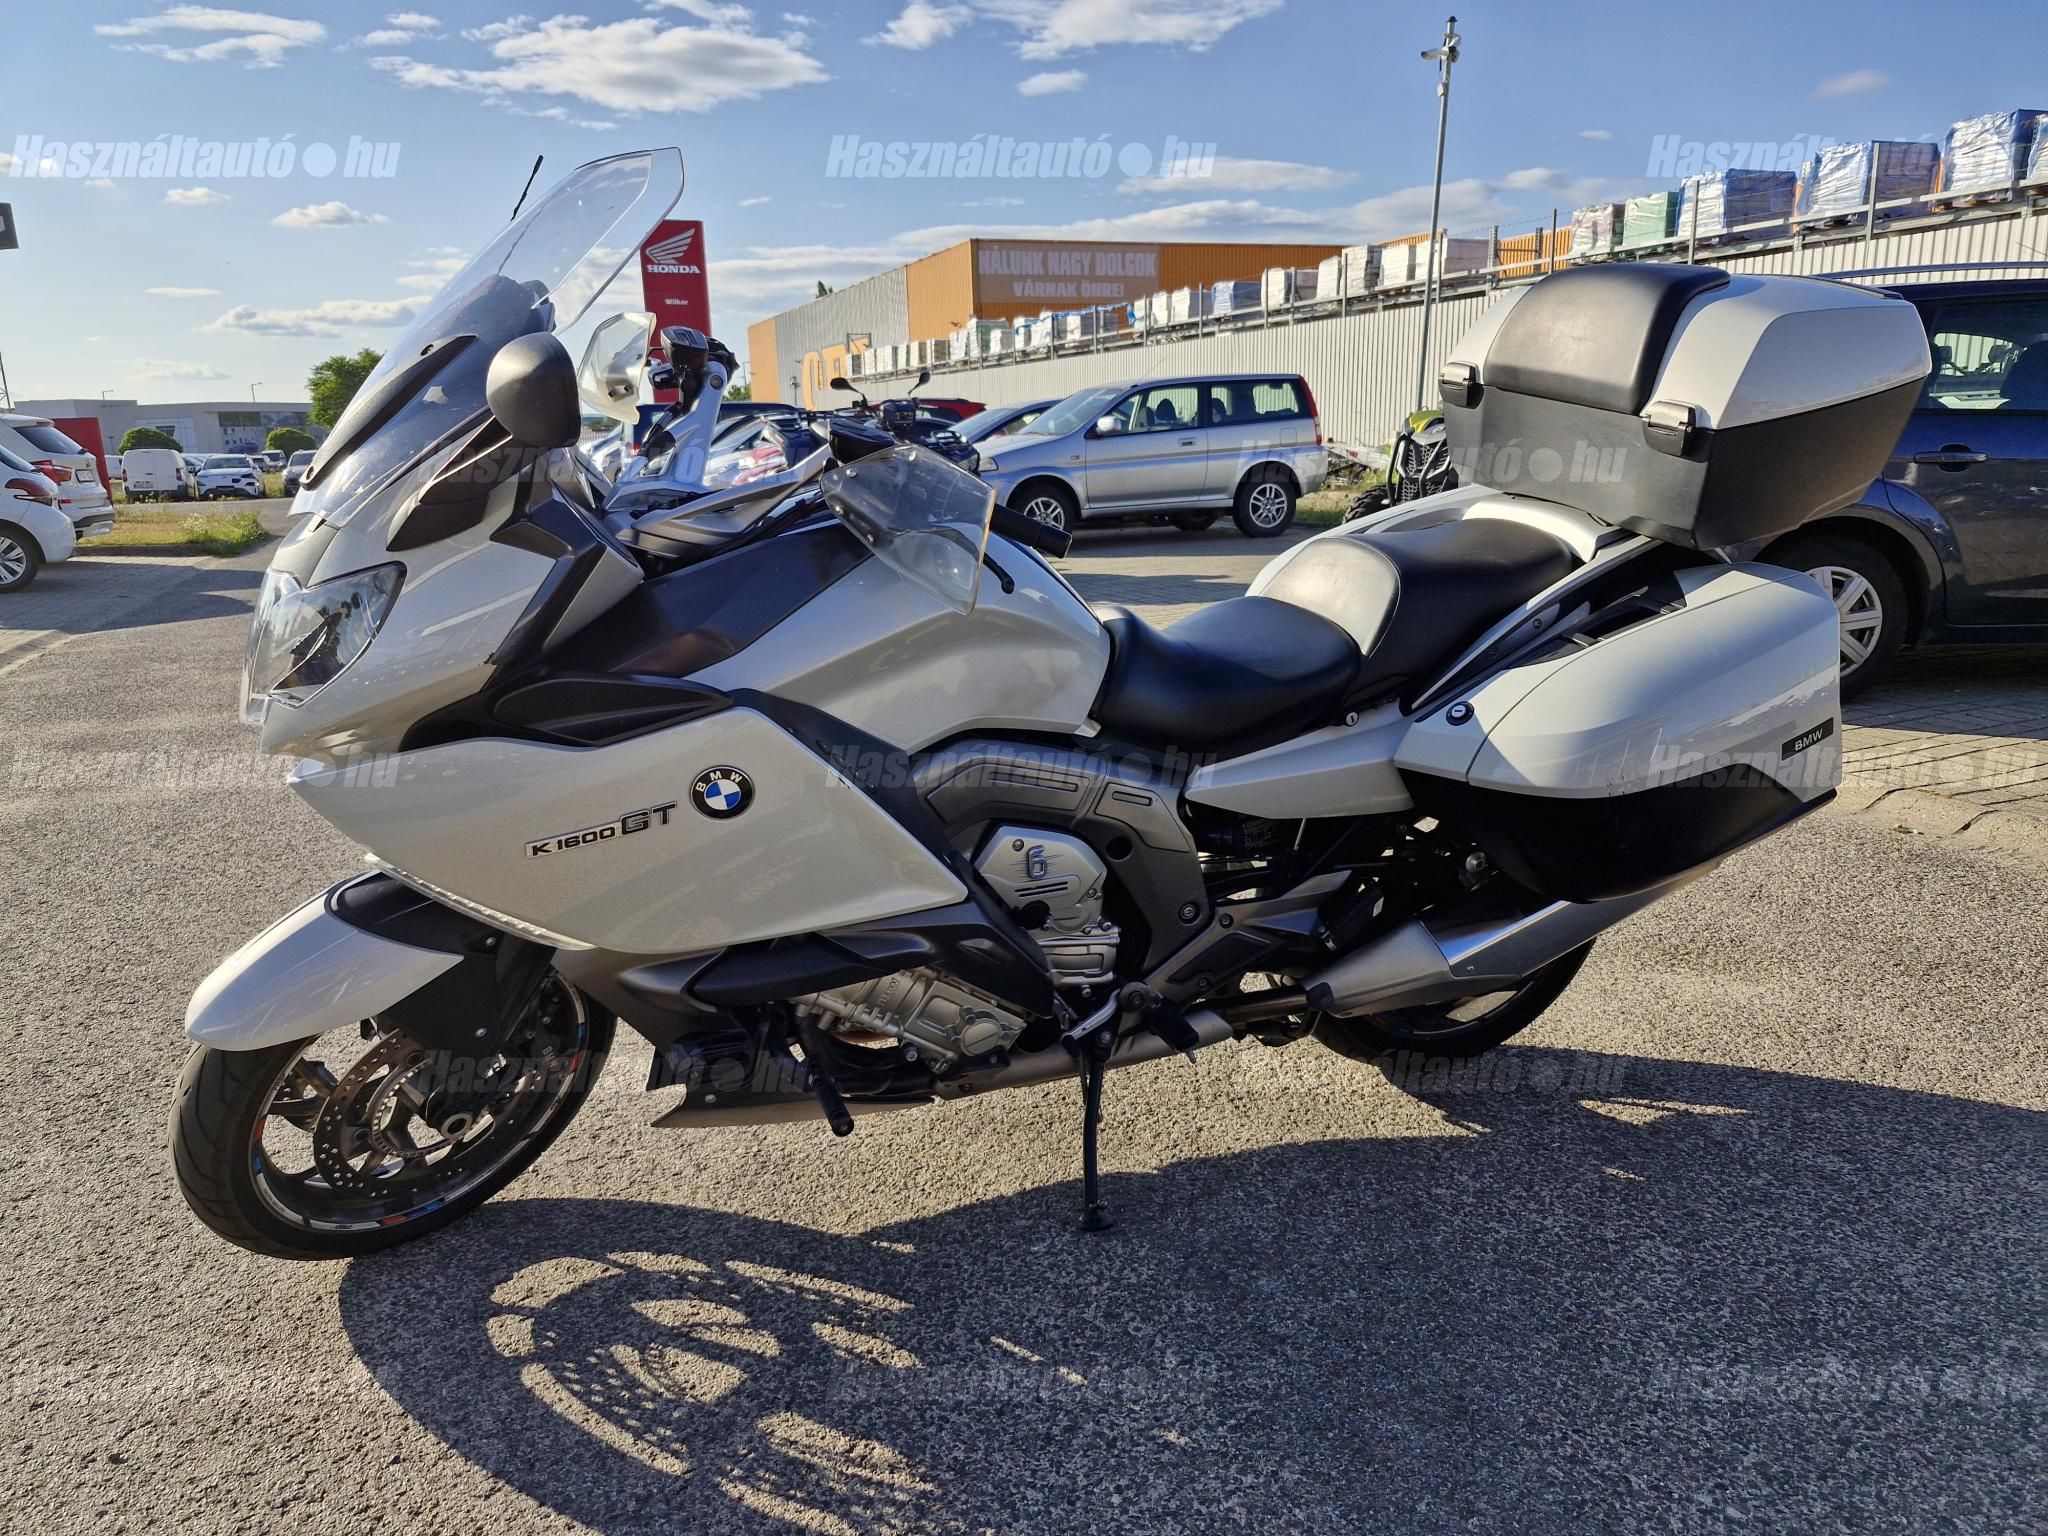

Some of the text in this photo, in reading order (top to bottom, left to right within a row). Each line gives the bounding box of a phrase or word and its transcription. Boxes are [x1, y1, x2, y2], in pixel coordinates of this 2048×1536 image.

[646, 264, 702, 274] HONDA
[979, 246, 1157, 277] NÁLUNK NAGY DOLGOK
[1013, 279, 1079, 297] VÁRNAK
[1794, 728, 1823, 751] BMW
[695, 770, 743, 793] BMW
[1026, 845, 1048, 880] 6
